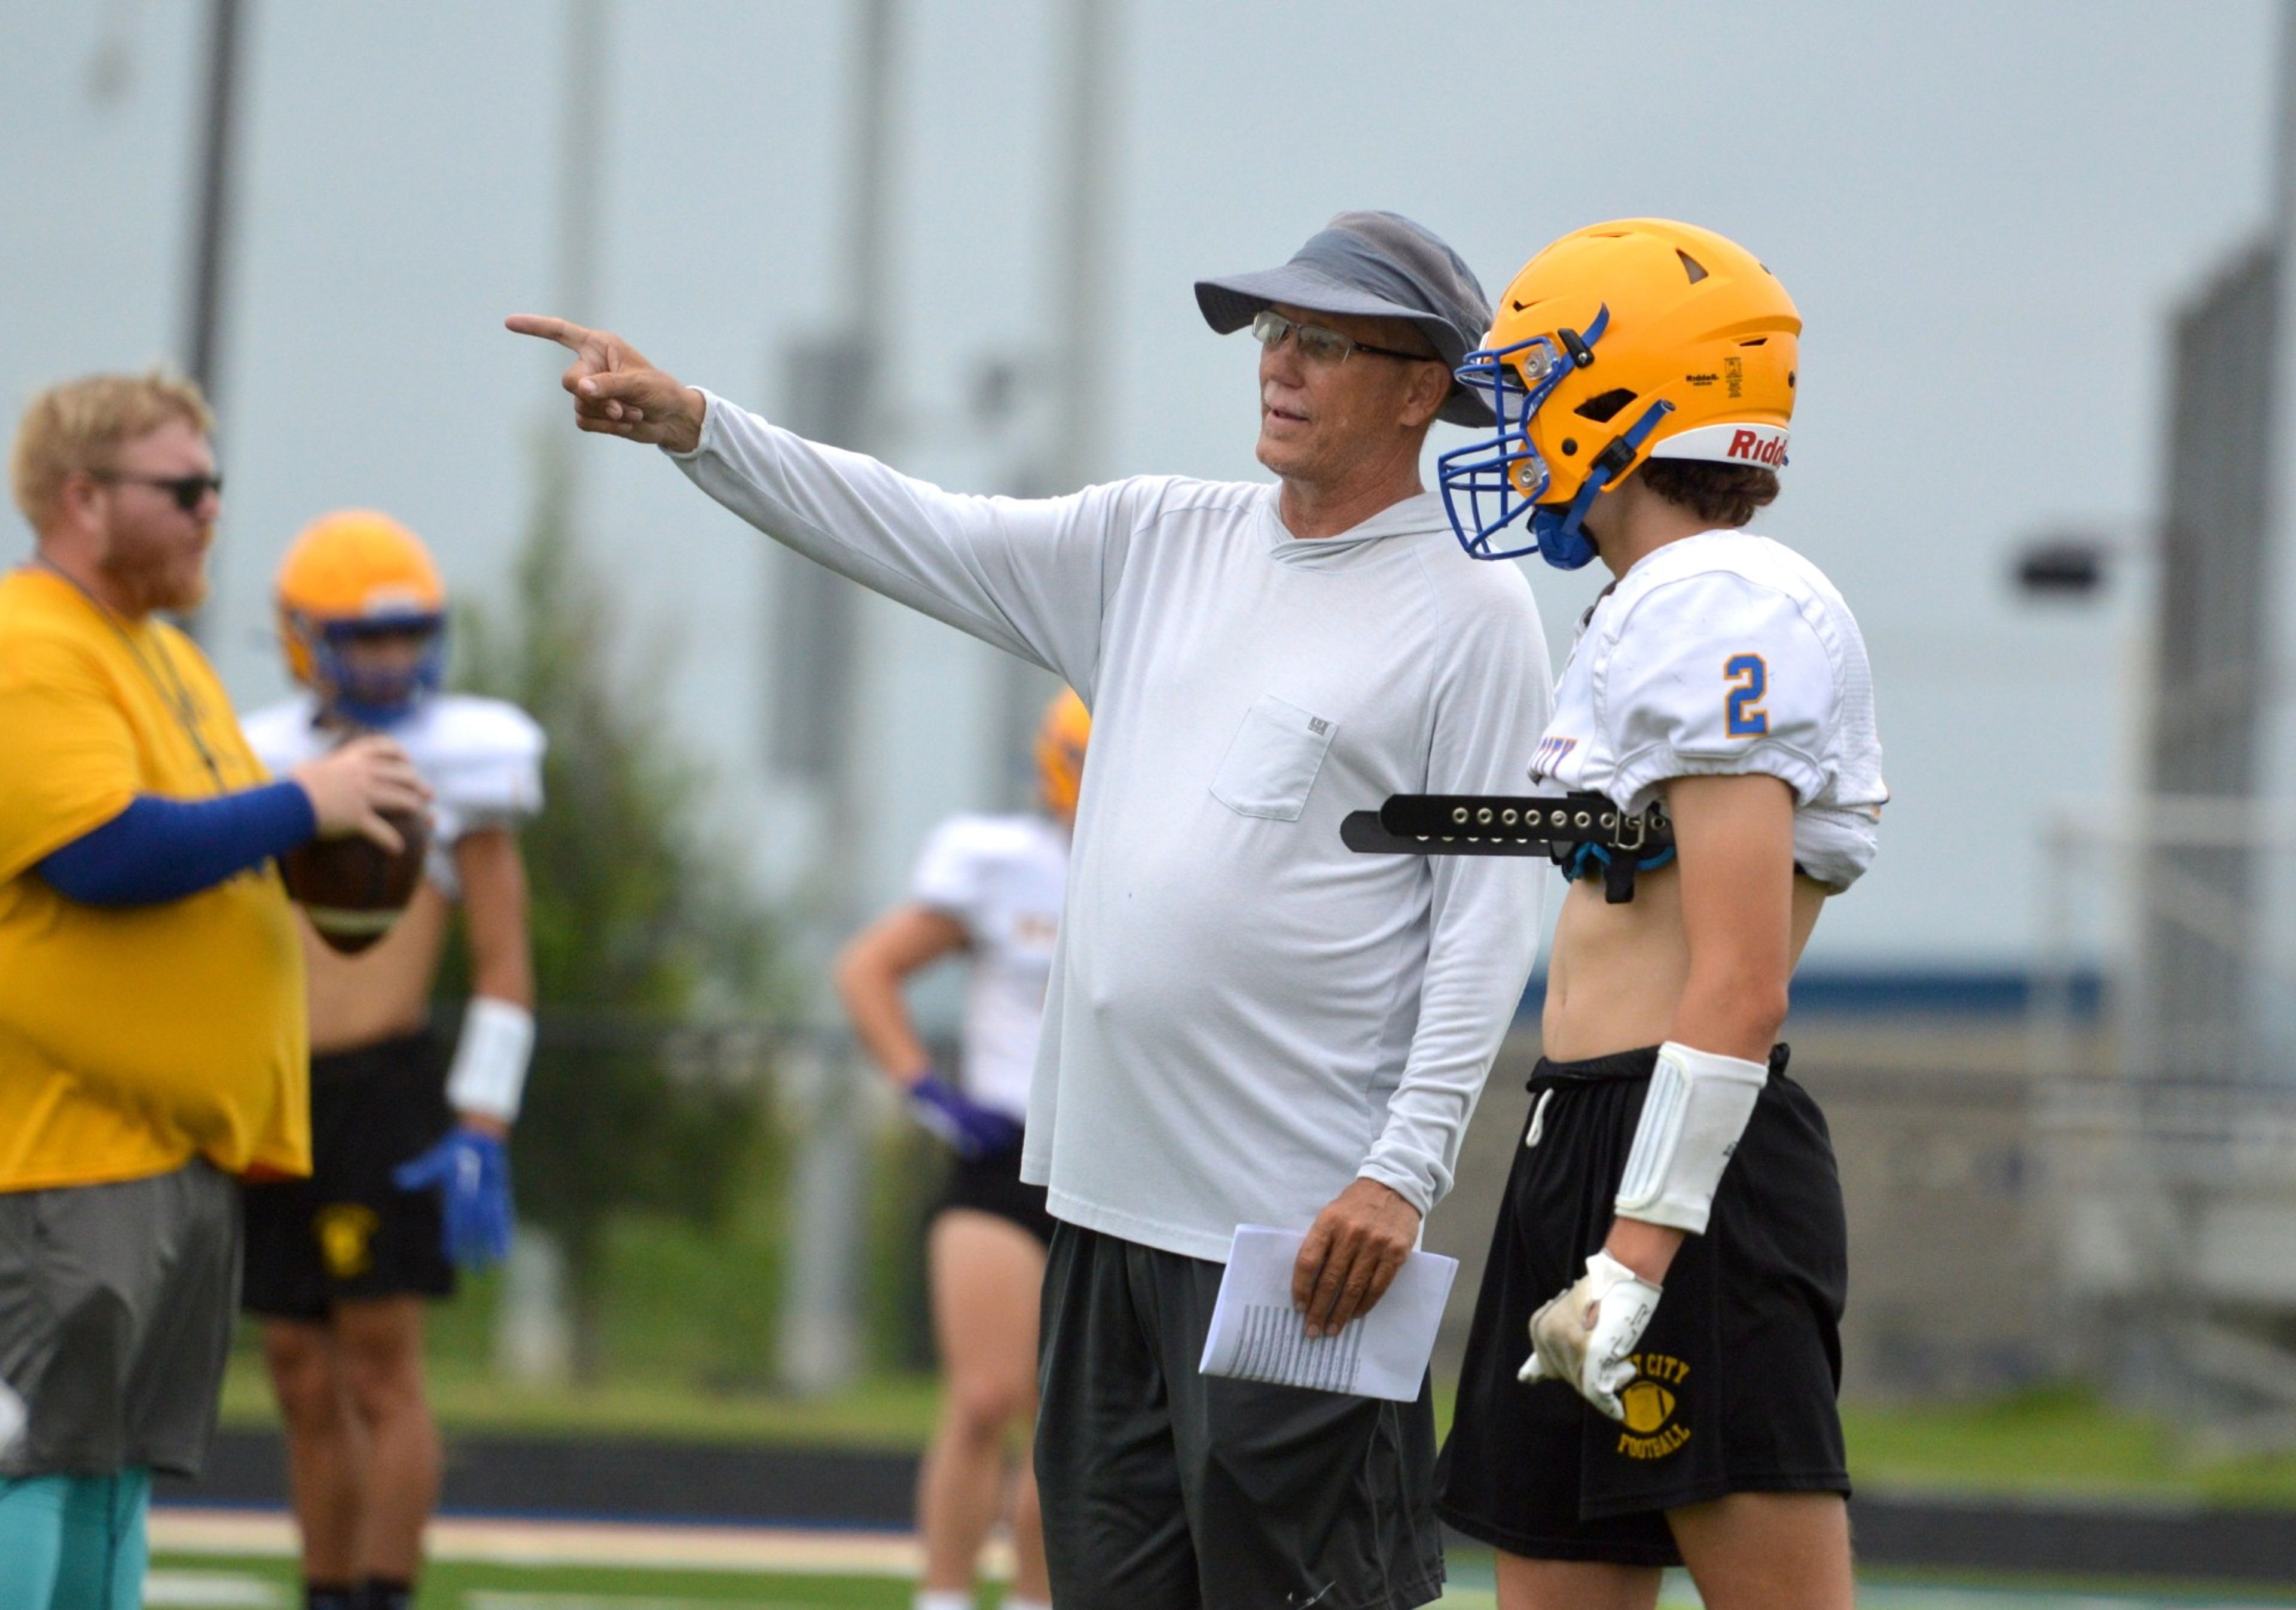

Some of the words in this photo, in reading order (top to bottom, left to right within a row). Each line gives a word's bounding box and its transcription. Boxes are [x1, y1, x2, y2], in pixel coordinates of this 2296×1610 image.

[1727, 429, 1787, 468] Ridd
[1723, 652, 1769, 739] 2
[1647, 1353, 1690, 1385] CITY
[1618, 1423, 1692, 1459] FOOTBALL
